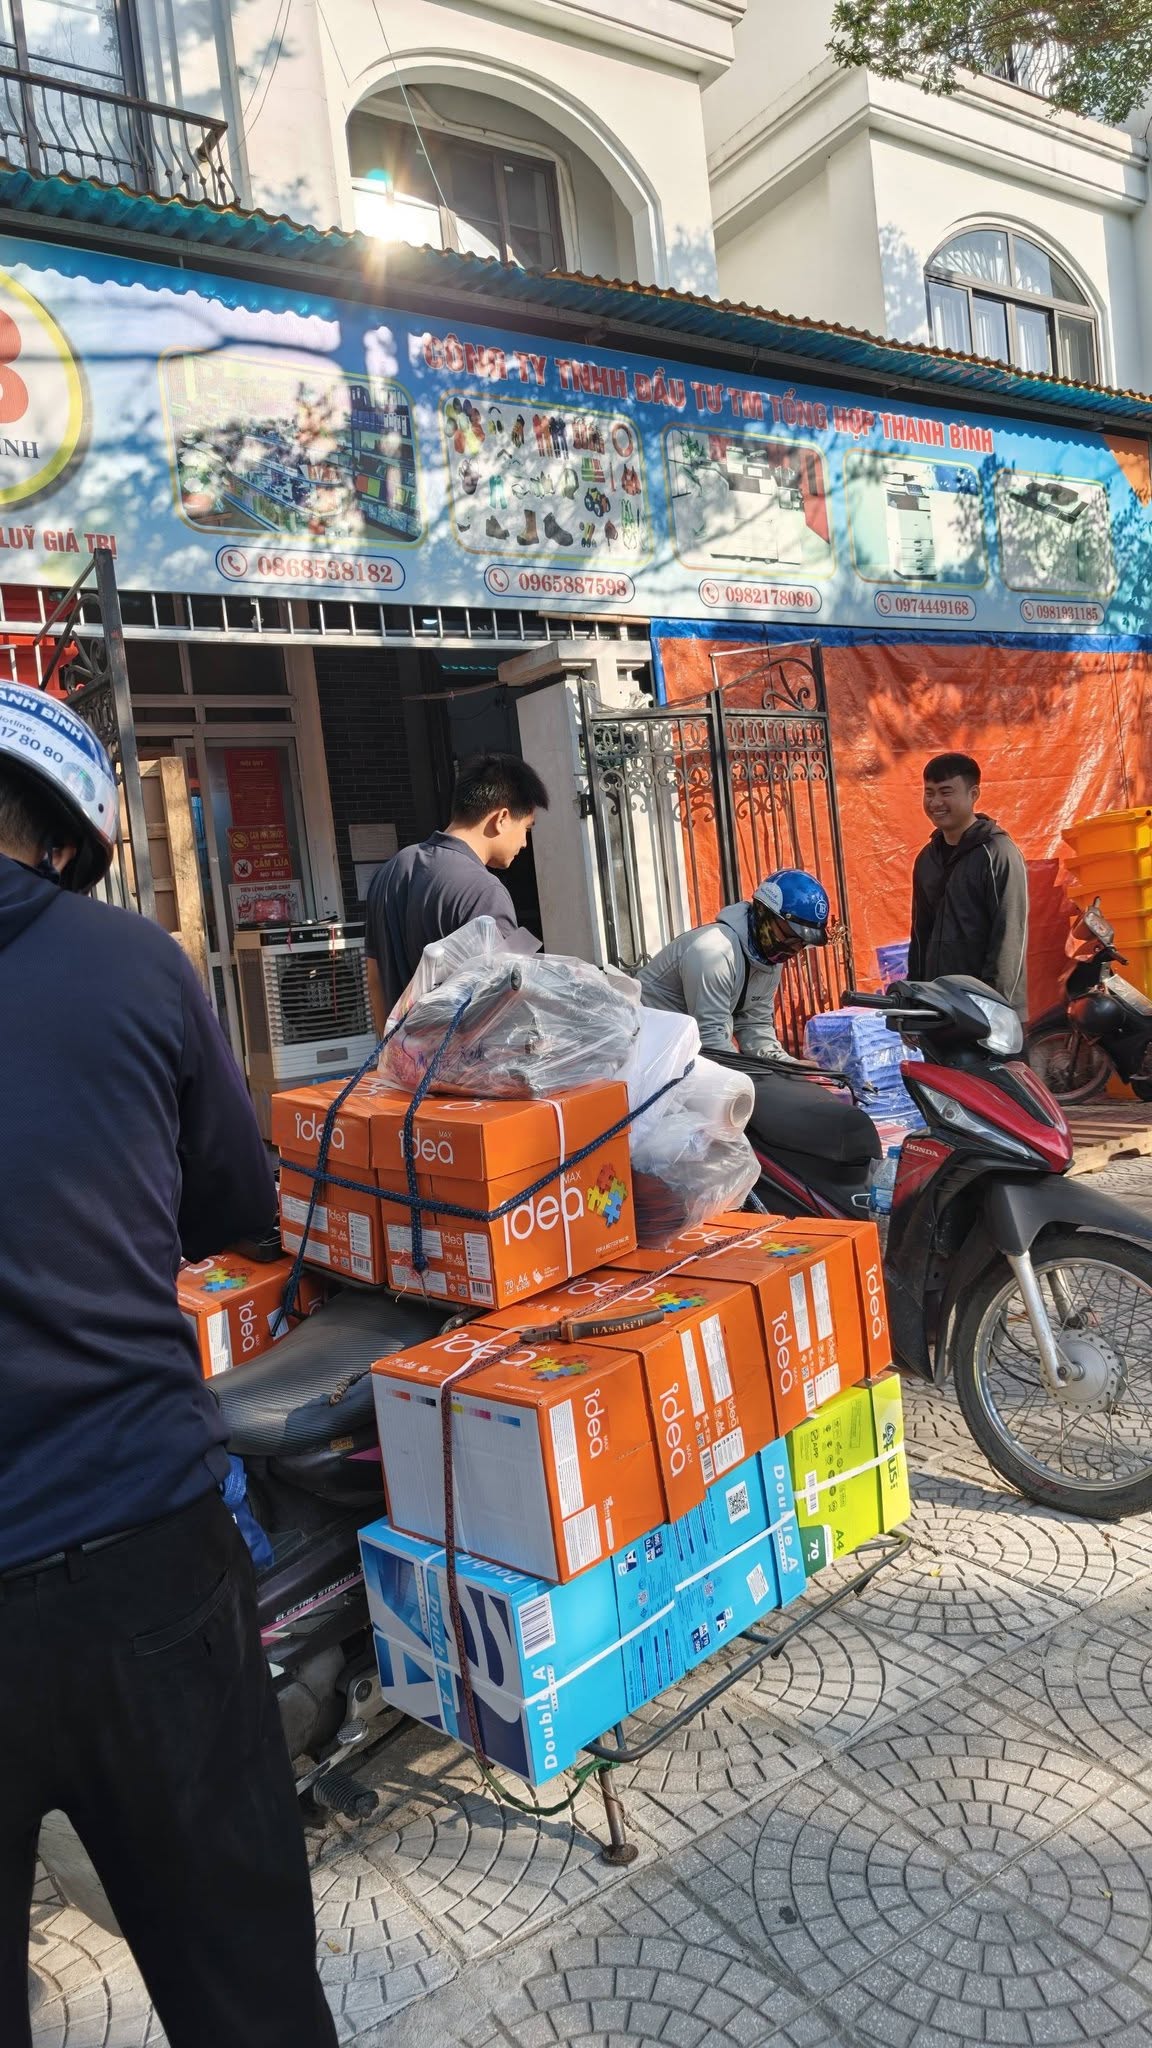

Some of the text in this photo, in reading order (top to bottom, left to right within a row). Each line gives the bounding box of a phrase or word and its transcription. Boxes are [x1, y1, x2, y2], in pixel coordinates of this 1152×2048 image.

[423, 333, 508, 380] CÔNG
[513, 351, 546, 386] TY
[554, 357, 628, 400] TNHH
[634, 367, 686, 408] ĐẦU
[691, 381, 724, 414] TƯ
[727, 387, 764, 421] TM
[768, 388, 829, 431] TỔNG
[832, 405, 875, 440] HỢP
[880, 412, 945, 448] THANH
[0, 437, 40, 459] NH
[43, 528, 79, 553] GIÁ
[257, 555, 393, 583] 0868538182
[518, 572, 627, 597] 0965887598
[725, 586, 813, 608] 0982178080
[895, 597, 969, 616] 0974449168
[1036, 604, 1099, 621] 0981931185
[0, 714, 36, 735] otline:
[19, 734, 41, 751] 80
[43, 745, 64, 764] 80
[294, 1111, 345, 1150] idea
[438, 1130, 453, 1138] MAX
[905, 1143, 940, 1158] HONDA
[500, 1170, 584, 1246] idea MAX
[678, 1230, 762, 1249] dea
[866, 1263, 882, 1340] idea
[238, 1299, 257, 1353] idea
[772, 1310, 793, 1396] idea
[584, 1388, 605, 1459] idea
[659, 1382, 685, 1478] idea
[809, 1538, 820, 1560] 70
[836, 1529, 845, 1551] A4
[457, 1554, 526, 1584] Double
[785, 1560, 799, 1573] A
[275, 1571, 356, 1622] ELECTRIC STARTER
[429, 1595, 448, 1680] Doube
[532, 1665, 547, 1680] A
